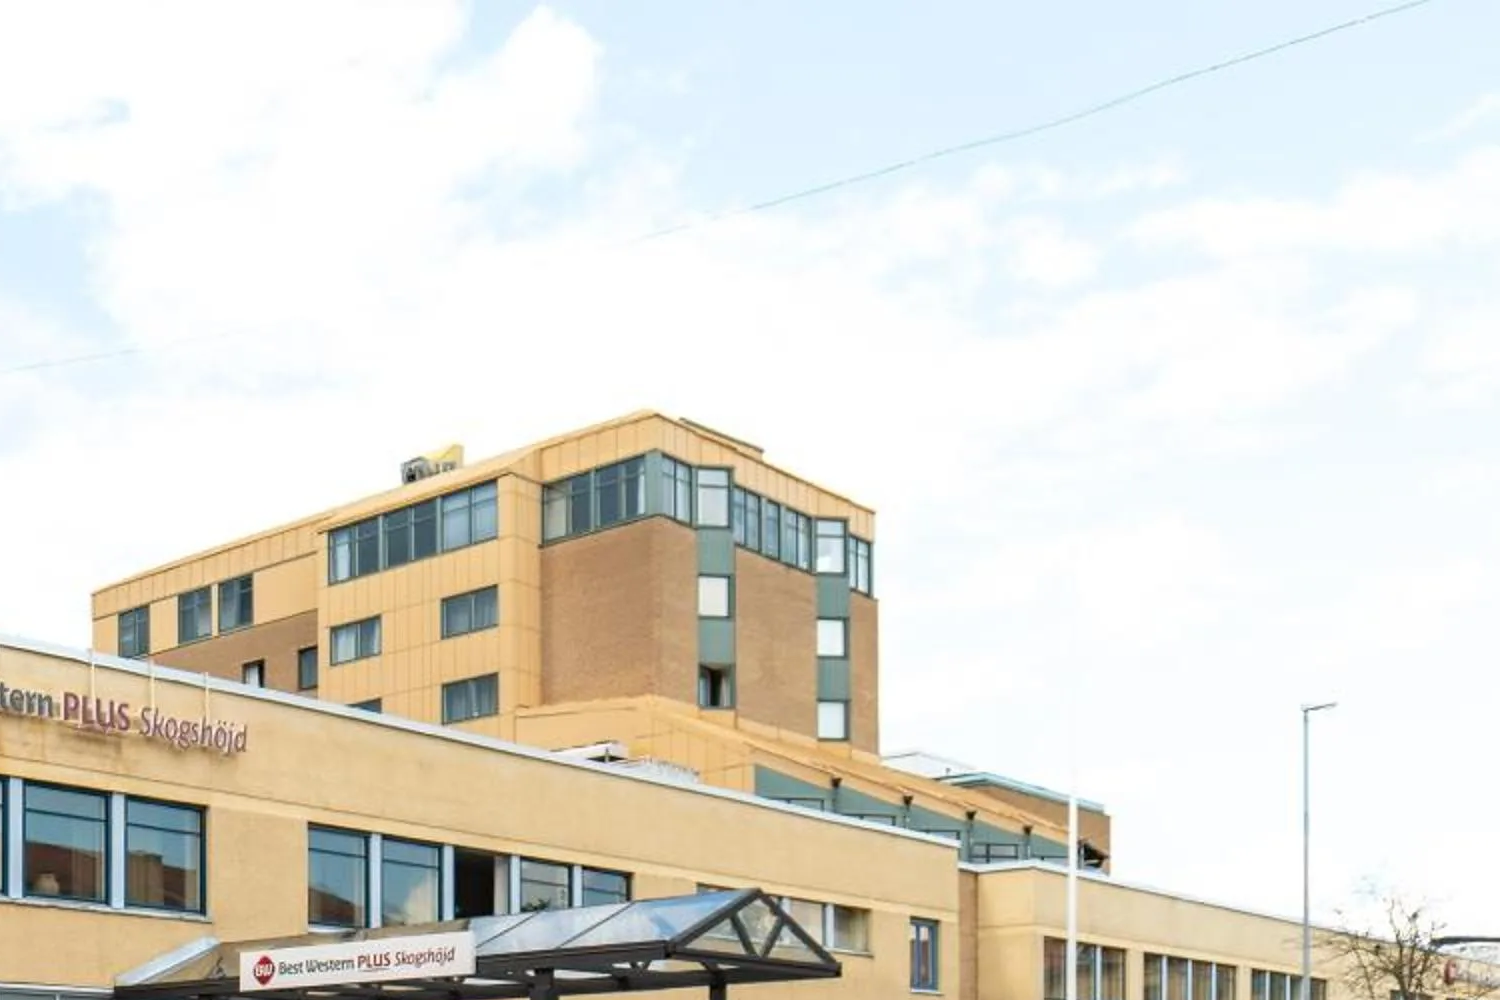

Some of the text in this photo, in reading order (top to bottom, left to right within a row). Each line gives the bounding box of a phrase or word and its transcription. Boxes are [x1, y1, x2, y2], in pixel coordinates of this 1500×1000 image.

[61, 691, 132, 731] PLUS
[139, 705, 248, 756] Skogshöjd
[279, 945, 456, 975] Best Western PLUS Skogshöjd
